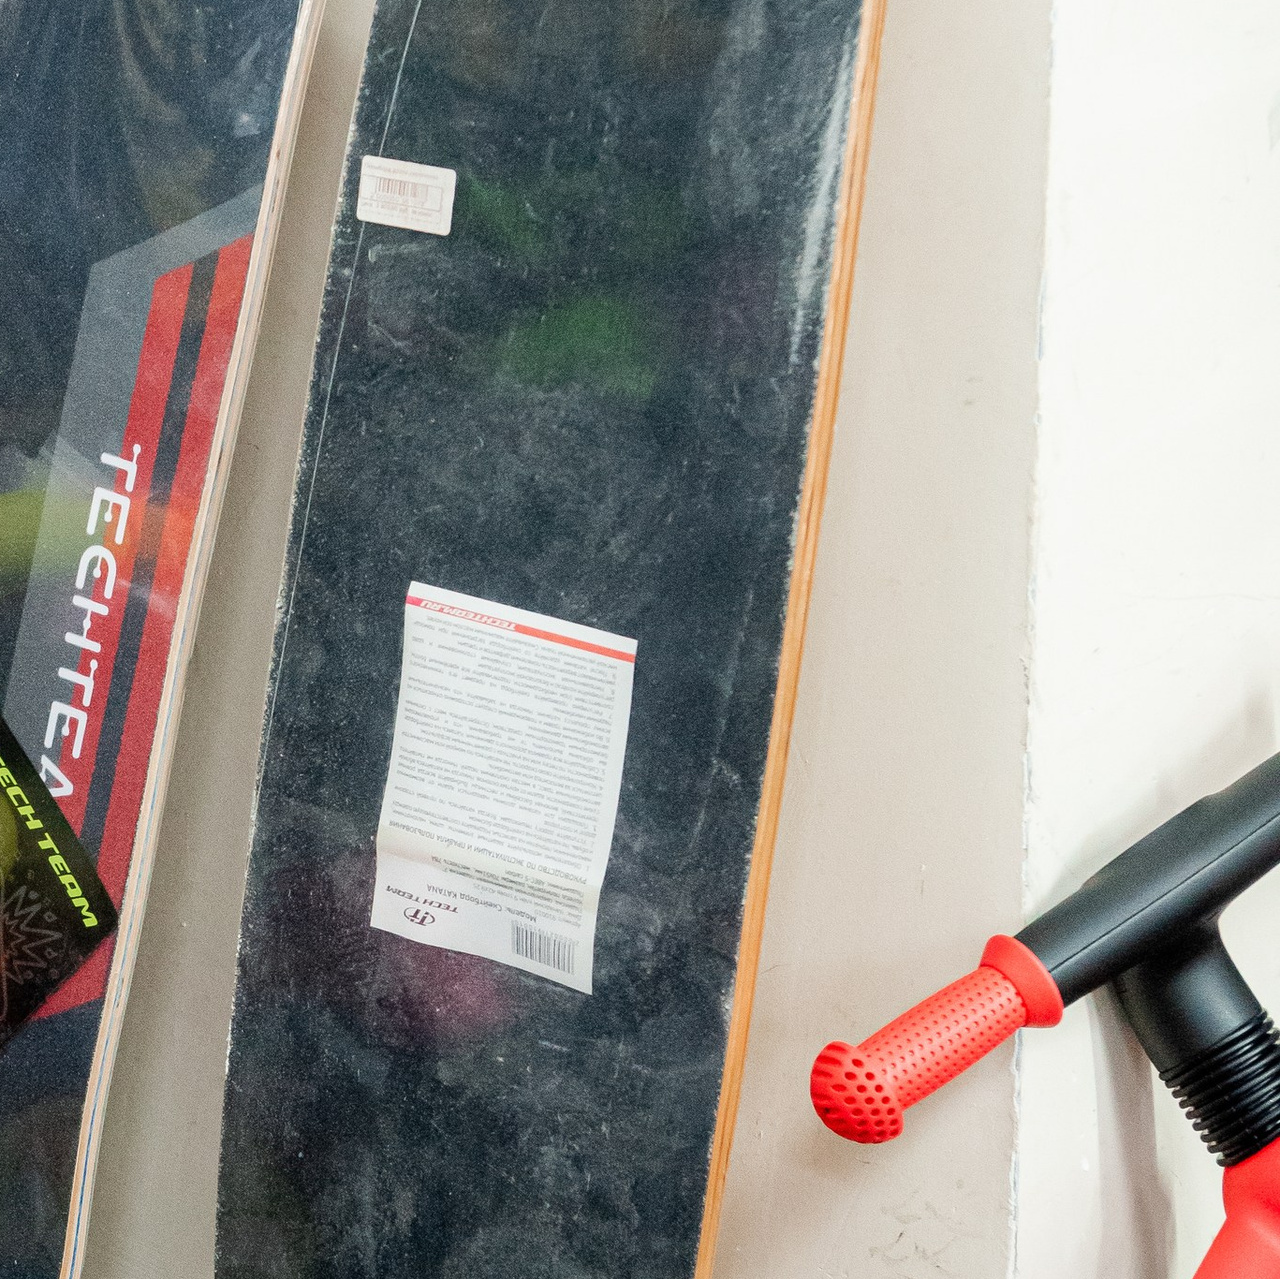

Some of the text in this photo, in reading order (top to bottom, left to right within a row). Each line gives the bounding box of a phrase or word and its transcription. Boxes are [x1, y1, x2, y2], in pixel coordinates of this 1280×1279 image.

[39, 443, 142, 799] TECHTEA
[38, 832, 98, 927] TEAM
[388, 819, 587, 885] РУКОВОДСТВО ПО ЭКСПЛУАТАЦИИ И ПРАВИЛА ПОЛЬЗОВАНИЯ
[384, 883, 459, 915] TECH TEAM
[425, 882, 537, 923] Модель: Скейтборд KATANA
